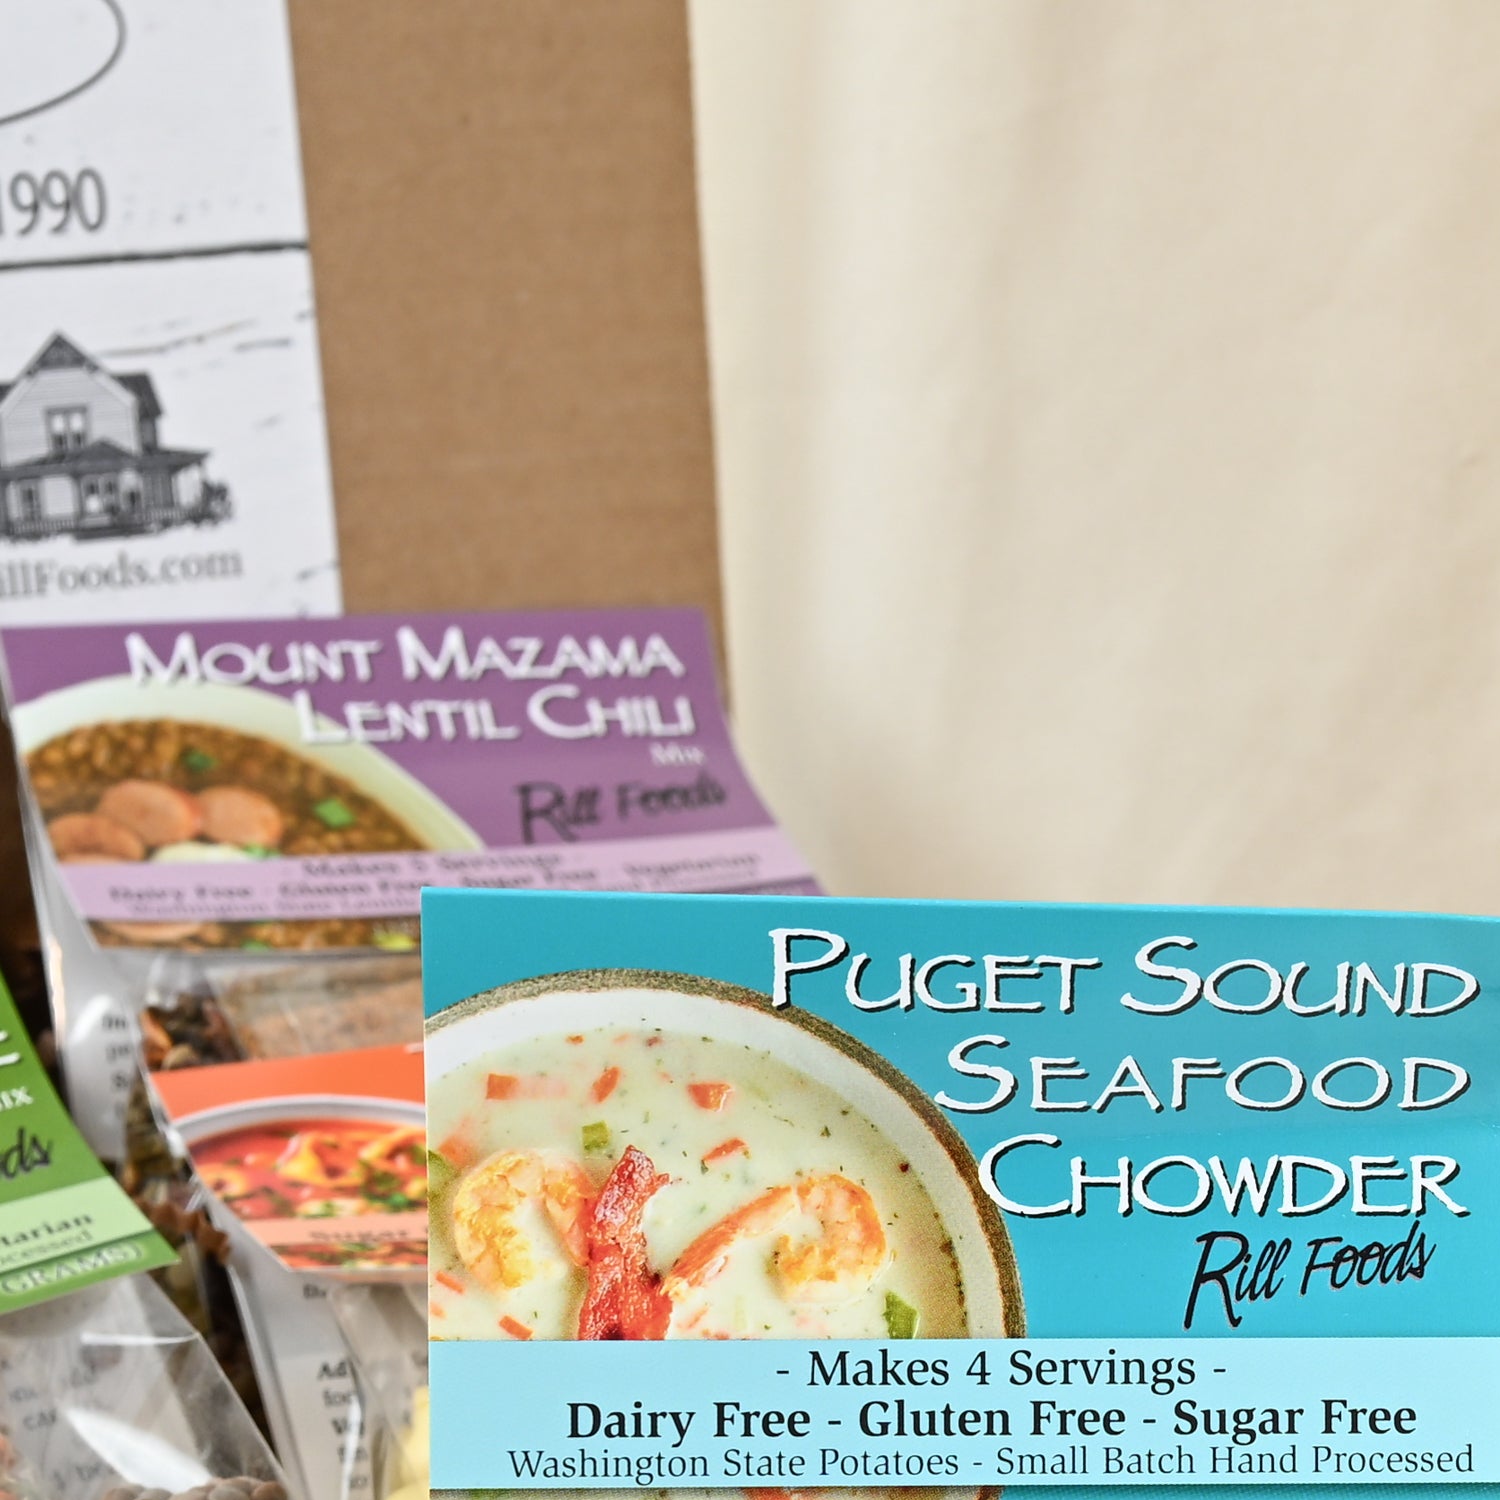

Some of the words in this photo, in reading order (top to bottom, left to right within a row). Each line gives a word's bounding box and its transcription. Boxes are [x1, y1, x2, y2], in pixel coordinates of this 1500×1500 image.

[125, 631, 384, 687] MOUNT
[396, 624, 688, 683] MAZAMA
[294, 689, 523, 744] LENTIL
[527, 683, 697, 741] CHILI
[769, 927, 1099, 1014] PUGET
[1120, 935, 1481, 1018] SOUND
[935, 1033, 1470, 1112] SEAFOOD
[978, 1132, 1470, 1218] CHOWDER
[1183, 1230, 1292, 1330] Rill
[1300, 1220, 1437, 1297] Foods
[807, 1349, 949, 1386] Makes
[966, 1350, 991, 1386] 4
[1009, 1347, 1196, 1395] Servings
[567, 1401, 696, 1447] Dairy
[713, 1402, 811, 1437] Free
[859, 1400, 1010, 1437] Gluten
[1030, 1401, 1126, 1436] Free
[1173, 1399, 1304, 1445] Sugar
[1321, 1400, 1417, 1435] Free
[507, 1448, 709, 1486] Washington
[723, 1448, 806, 1477] State
[819, 1448, 959, 1476] Potatoes
[997, 1446, 1089, 1475] Small
[1103, 1446, 1195, 1475] Batch
[1210, 1445, 1299, 1474] Hand
[1313, 1444, 1475, 1473] Processed
